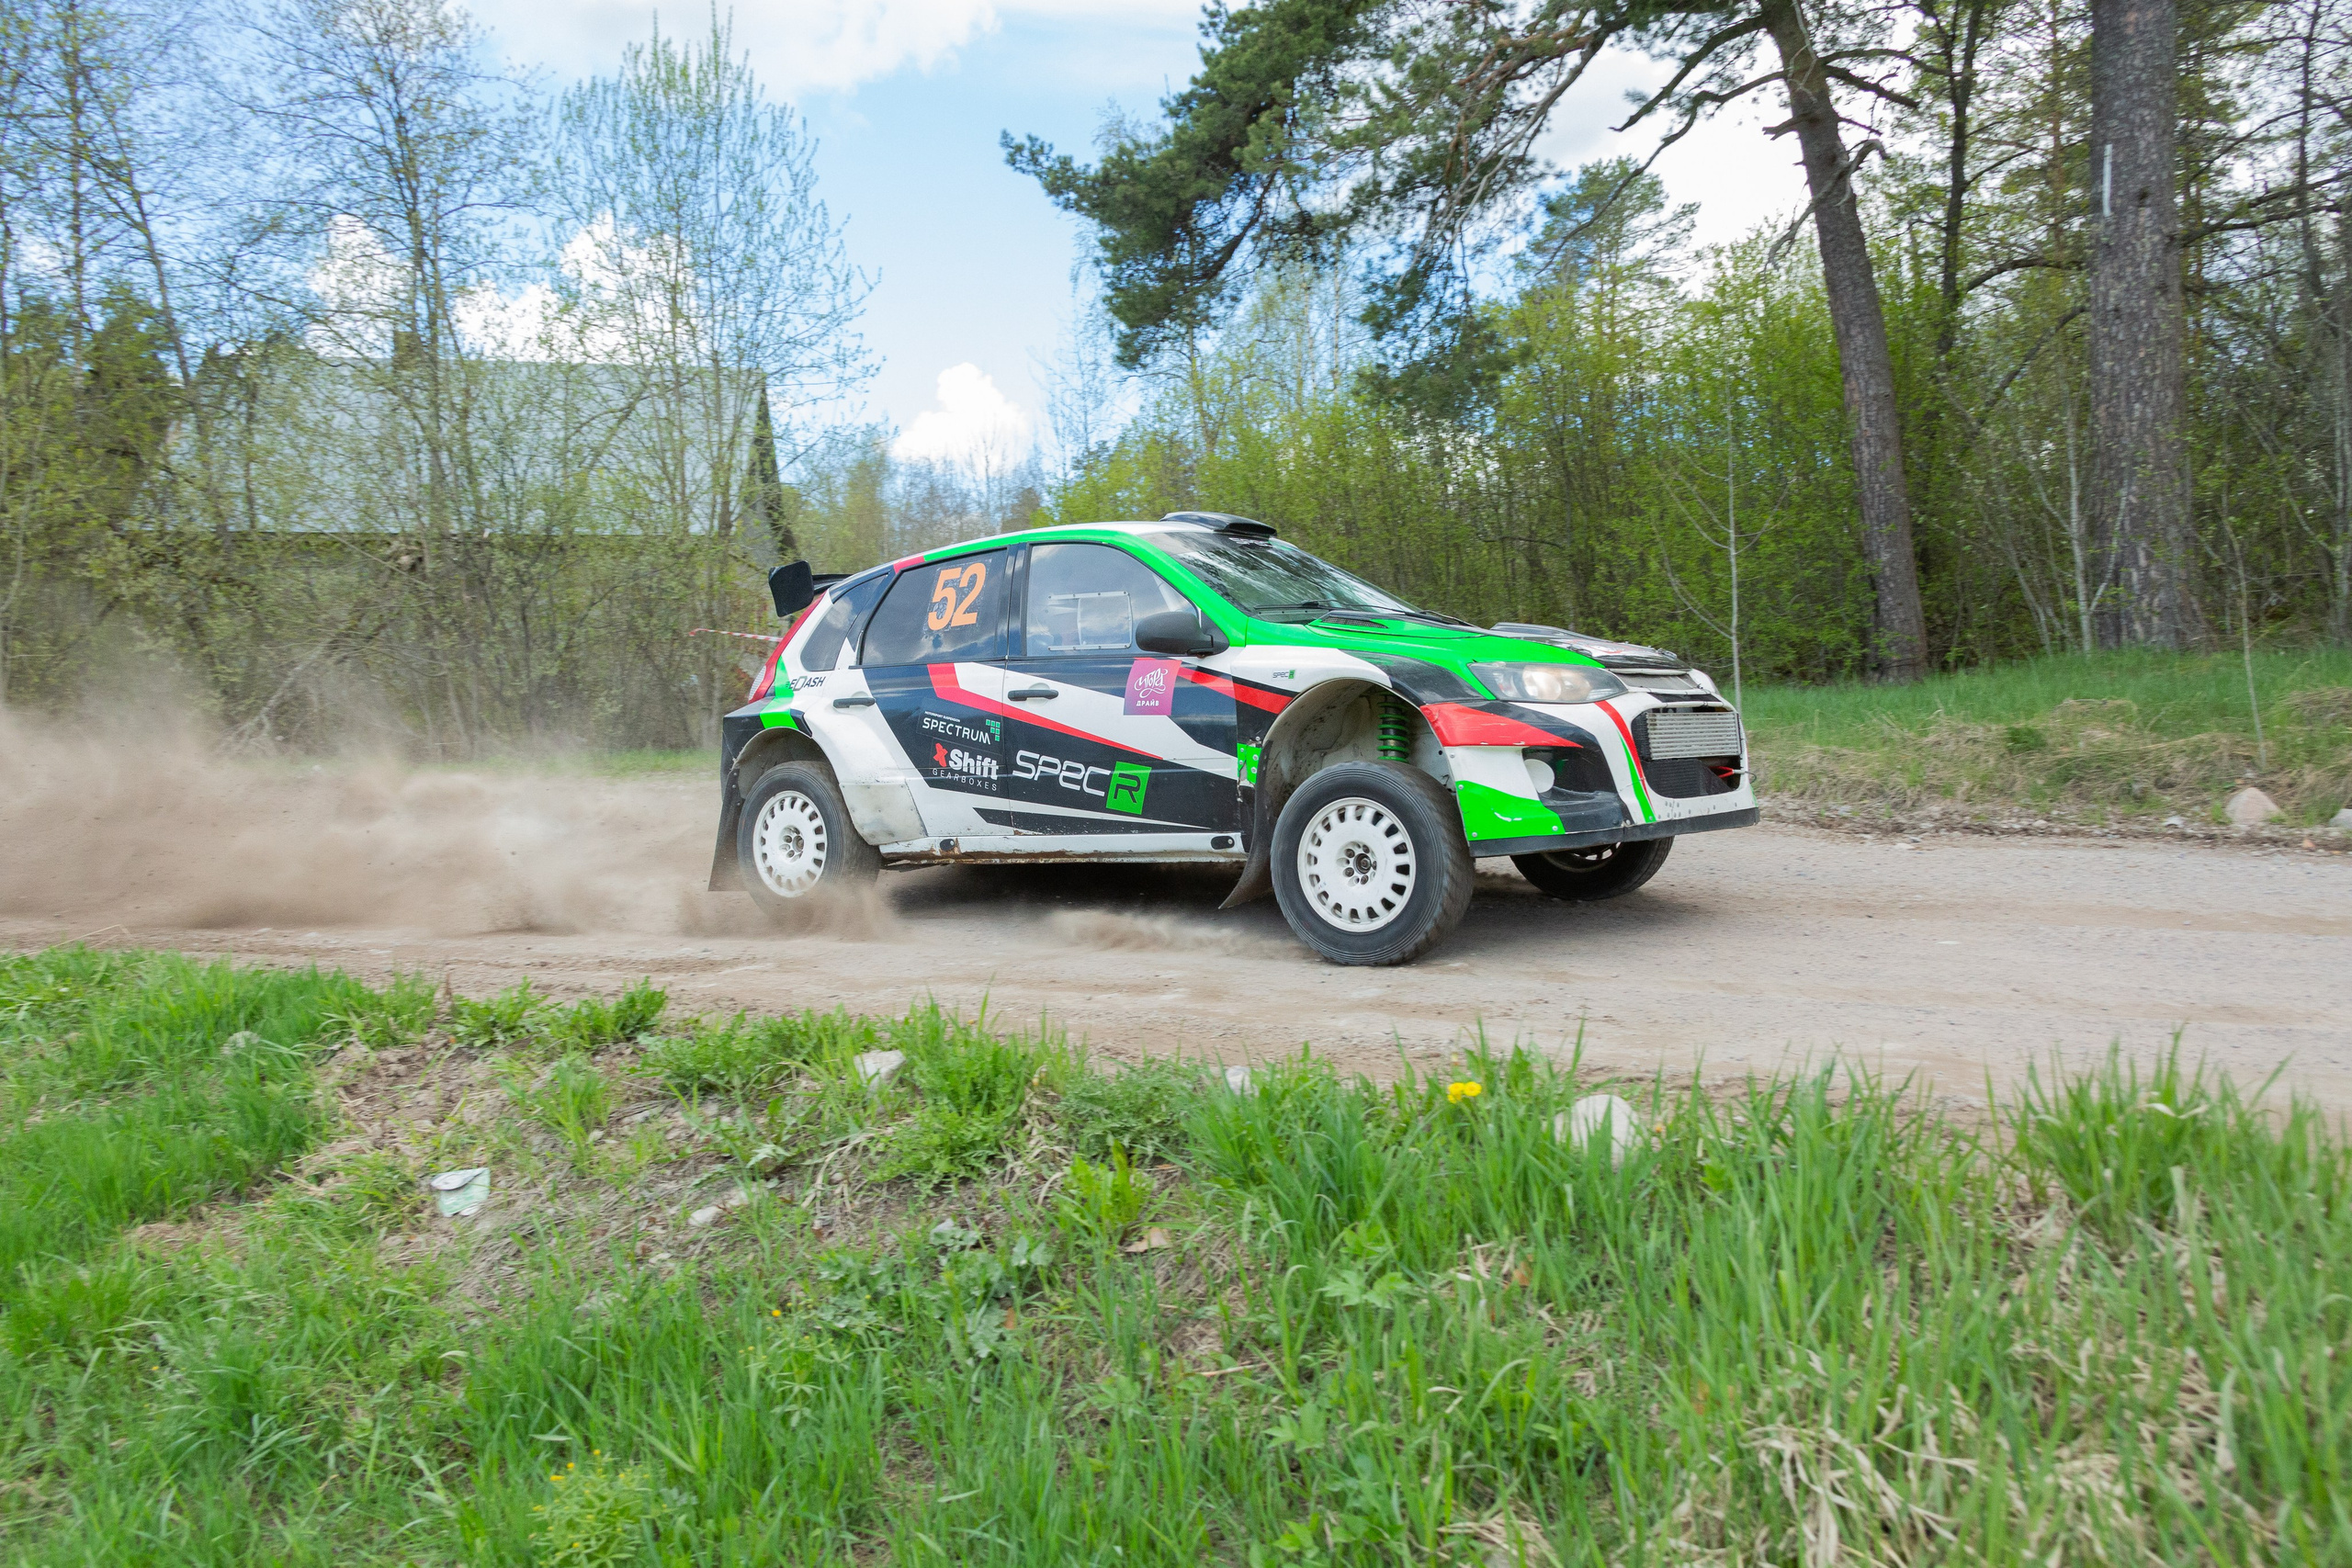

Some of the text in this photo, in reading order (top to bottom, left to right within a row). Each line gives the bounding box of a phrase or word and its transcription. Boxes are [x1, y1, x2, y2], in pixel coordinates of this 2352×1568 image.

[928, 562, 986, 631] 52
[922, 717, 990, 745] SPECTRUM
[933, 768, 997, 791] GEARBOXES
